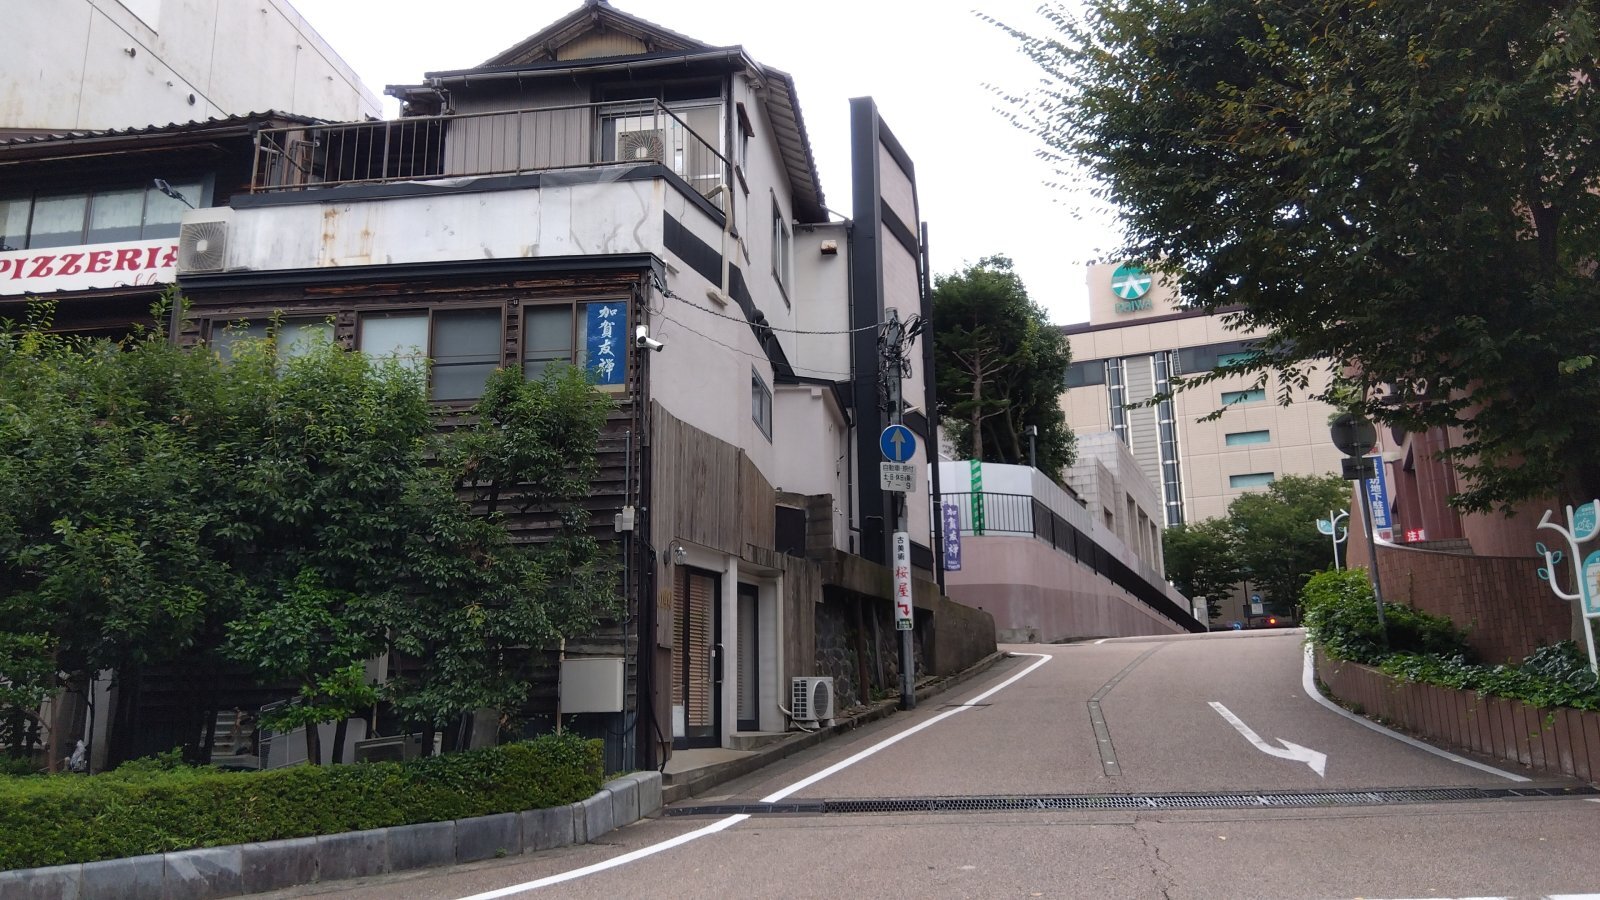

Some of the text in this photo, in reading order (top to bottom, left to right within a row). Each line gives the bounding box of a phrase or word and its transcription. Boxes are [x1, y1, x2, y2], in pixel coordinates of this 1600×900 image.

[0, 246, 179, 280] PIZZERIA
[597, 305, 618, 382] 加賀友禅
